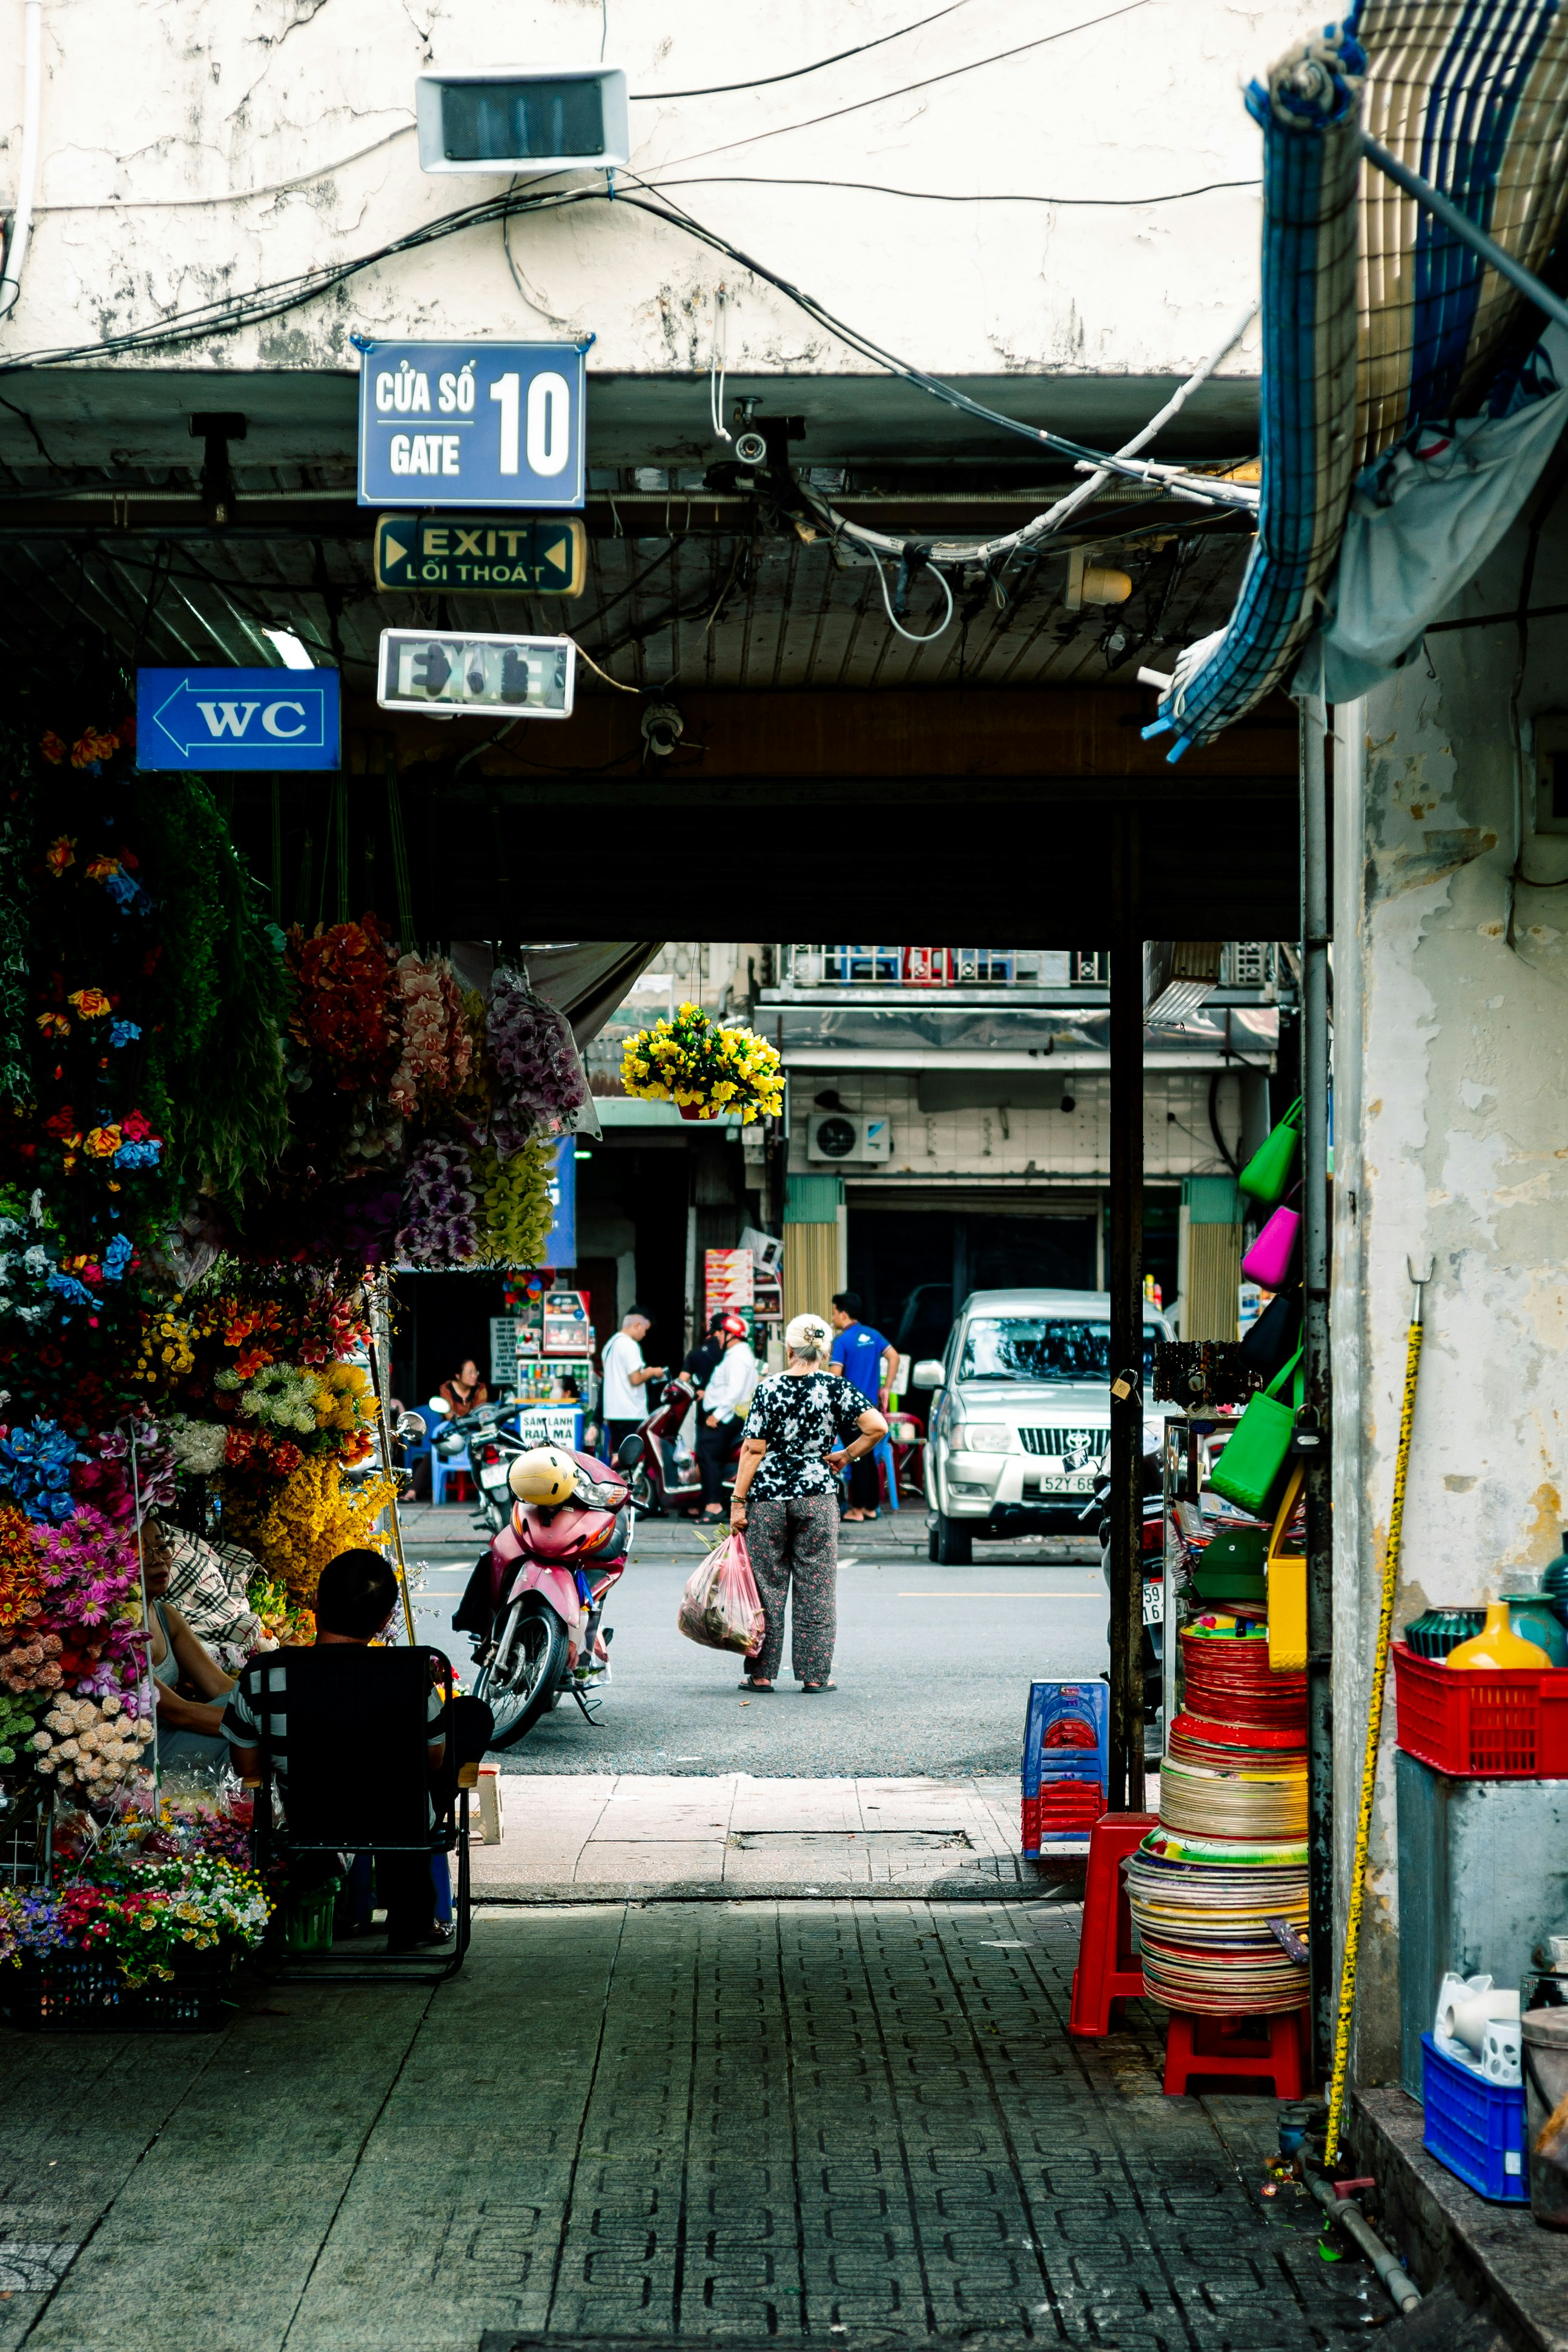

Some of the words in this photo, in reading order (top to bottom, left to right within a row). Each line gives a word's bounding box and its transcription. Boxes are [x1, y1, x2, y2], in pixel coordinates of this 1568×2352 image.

[376, 360, 431, 412] CỬA
[438, 360, 476, 412] SỐ
[490, 372, 570, 477] 10
[390, 434, 460, 476] GATE
[423, 529, 527, 557] EXIT
[406, 558, 448, 580] LỐI
[456, 562, 545, 582] THOÁT
[196, 701, 306, 737] WC
